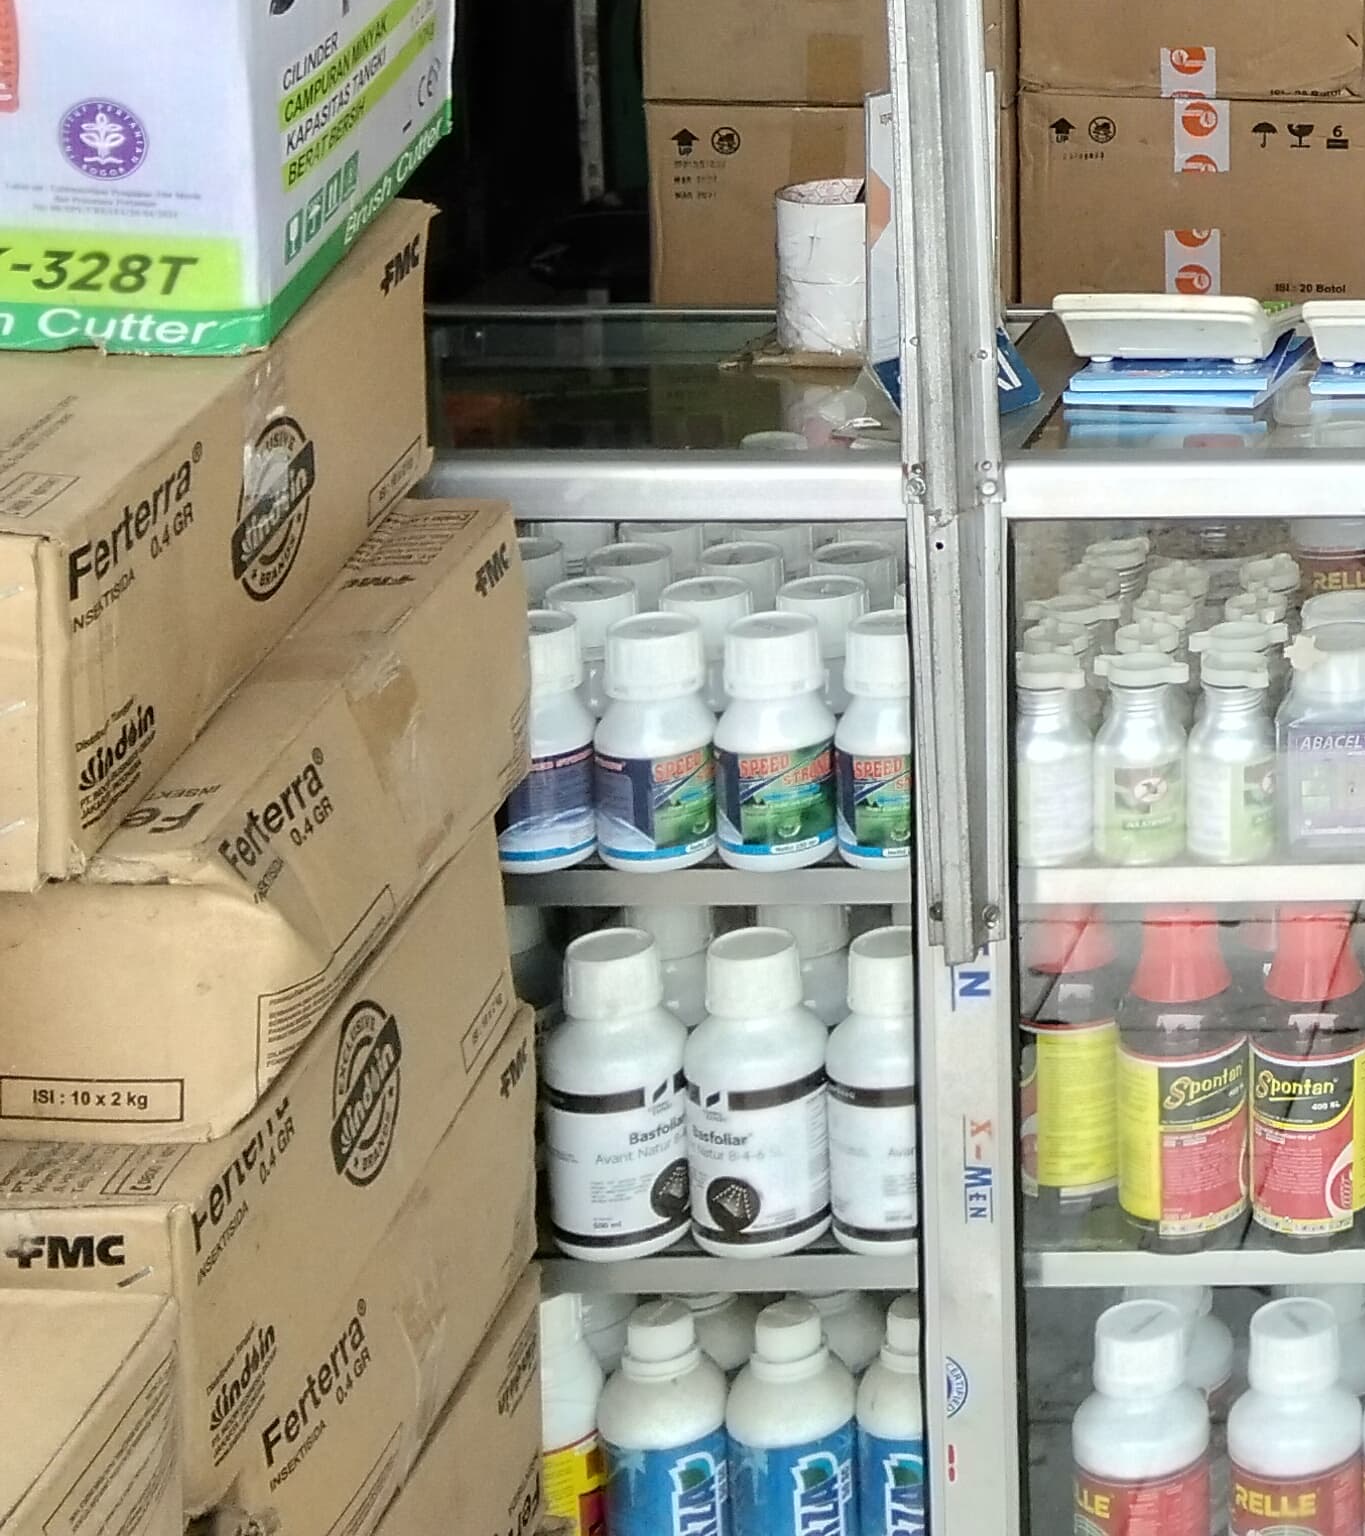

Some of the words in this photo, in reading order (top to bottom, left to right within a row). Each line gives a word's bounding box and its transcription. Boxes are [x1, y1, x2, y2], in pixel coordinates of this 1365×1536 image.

[281, 31, 340, 90] CILINDER
[283, 51, 353, 124] CAMPURAN
[351, 13, 389, 71] MINYAK
[285, 80, 352, 155] KAPASITAS
[287, 138, 327, 186] BERAT
[343, 170, 394, 247] Brush
[380, 232, 422, 296] FMC
[37, 308, 221, 346] Cutter
[473, 540, 511, 599] FMC
[739, 754, 789, 777] SPEED
[1299, 733, 1364, 751] ABACEL
[853, 757, 904, 781] SPEED
[32, 1089, 57, 1105] ISI
[71, 1089, 92, 1107] 10
[95, 1094, 107, 1108] x
[111, 1090, 122, 1108] 2
[126, 1090, 149, 1111] kg
[1256, 1070, 1336, 1100] Spontan
[594, 1149, 633, 1166] Avant
[637, 1138, 671, 1160] Natur
[5, 1234, 126, 1270] FMC
[260, 1316, 367, 1469] Ferterra
[269, 1418, 327, 1492] INSEKTISIDA
